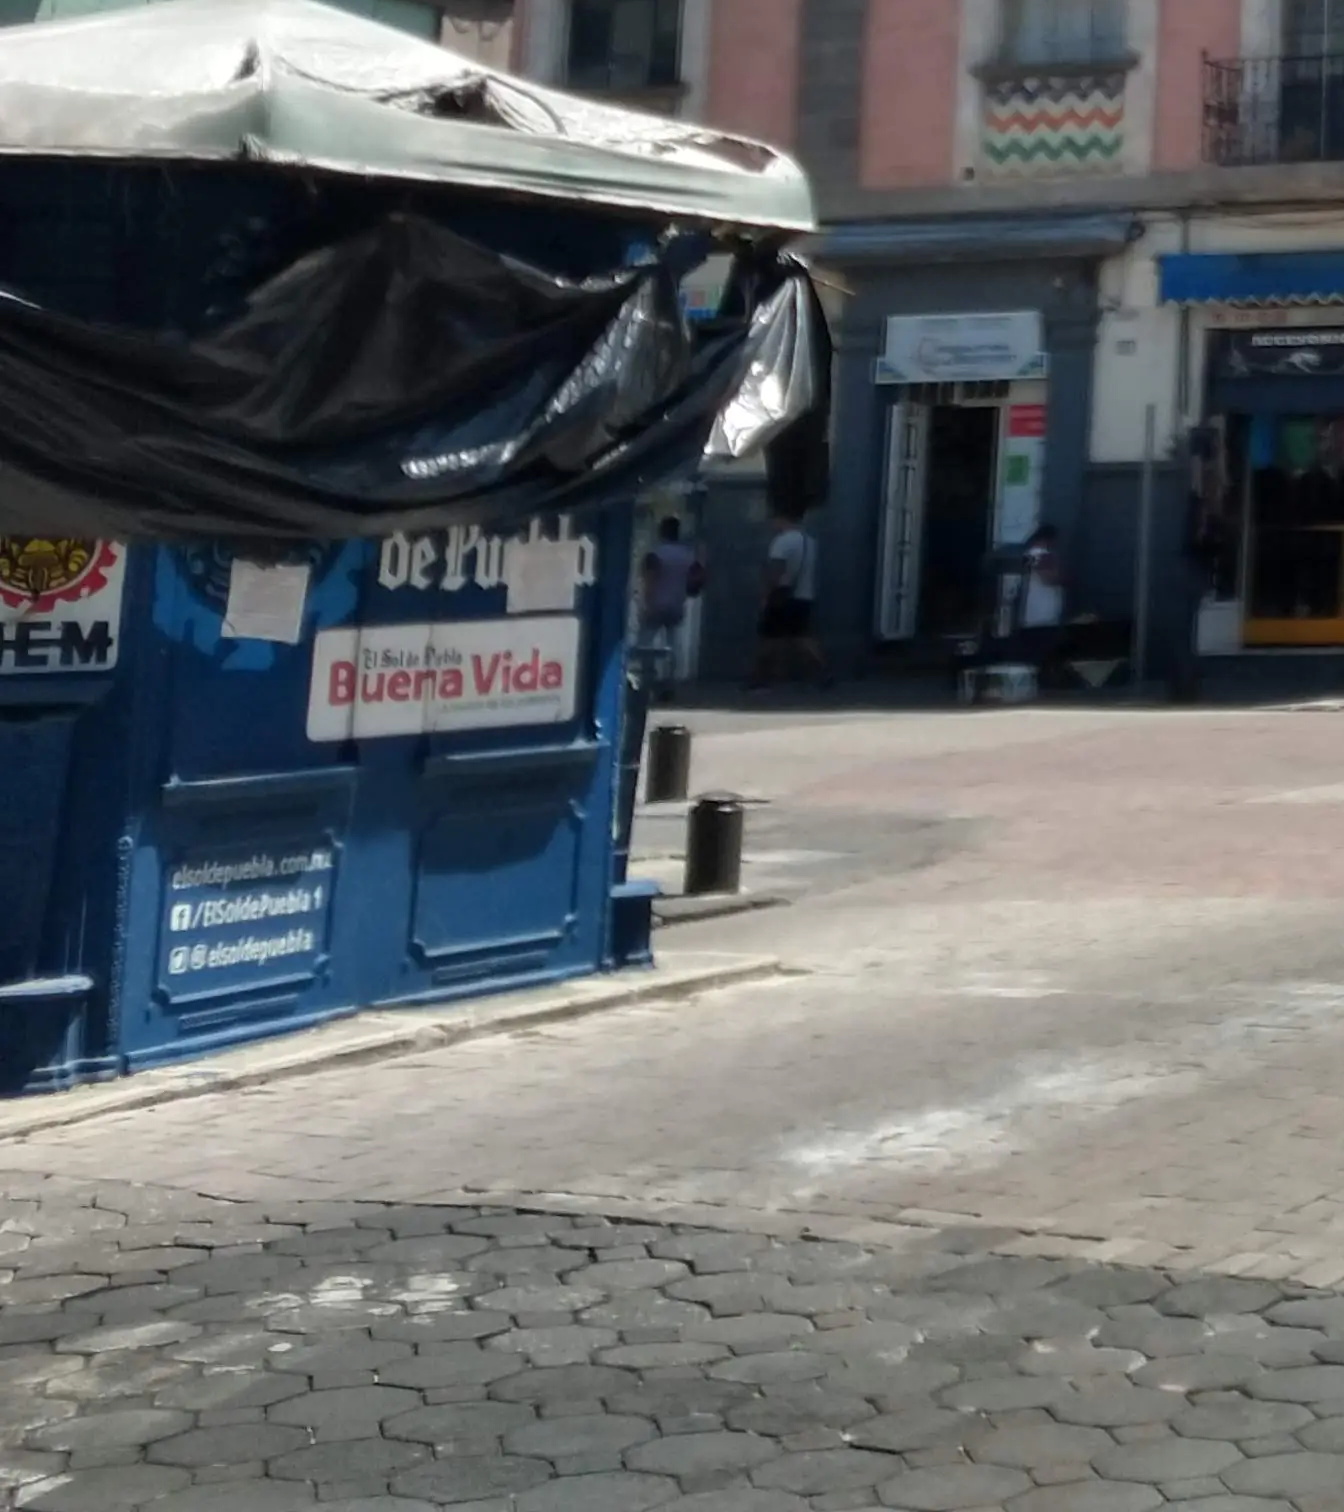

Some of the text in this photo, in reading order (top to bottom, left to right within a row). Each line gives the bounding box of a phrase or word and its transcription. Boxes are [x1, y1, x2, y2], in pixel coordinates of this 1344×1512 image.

[378, 529, 437, 591] de
[328, 647, 563, 707] Buena Vida
[172, 851, 333, 891] elsoldepuebla.com.mx
